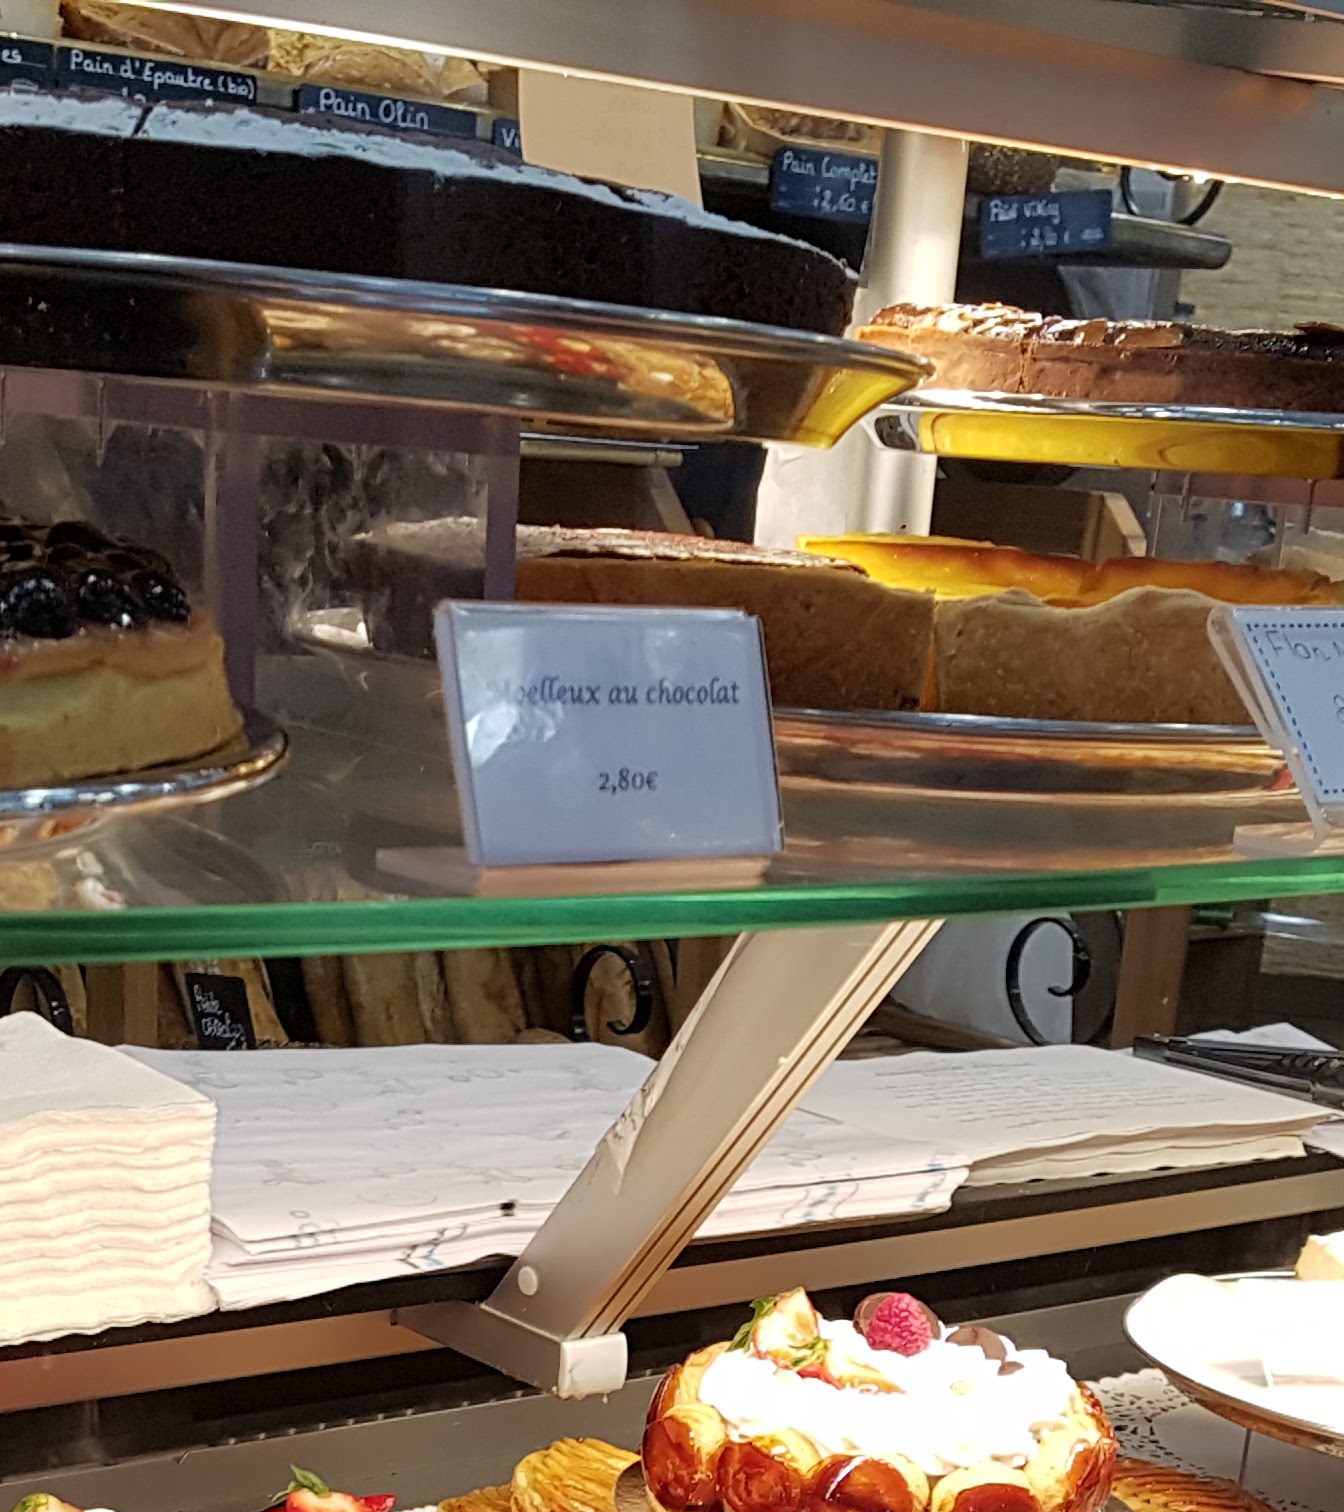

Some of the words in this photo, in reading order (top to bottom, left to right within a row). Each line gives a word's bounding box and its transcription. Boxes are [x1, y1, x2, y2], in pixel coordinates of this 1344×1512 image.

[69, 49, 114, 75] Pain
[217, 75, 255, 100] (bio)
[319, 87, 371, 120] Pain
[378, 98, 430, 130] Olin
[782, 150, 816, 176] Pain
[608, 680, 638, 705] au
[646, 675, 740, 705] chocolat
[598, 766, 658, 796] 2,80€
